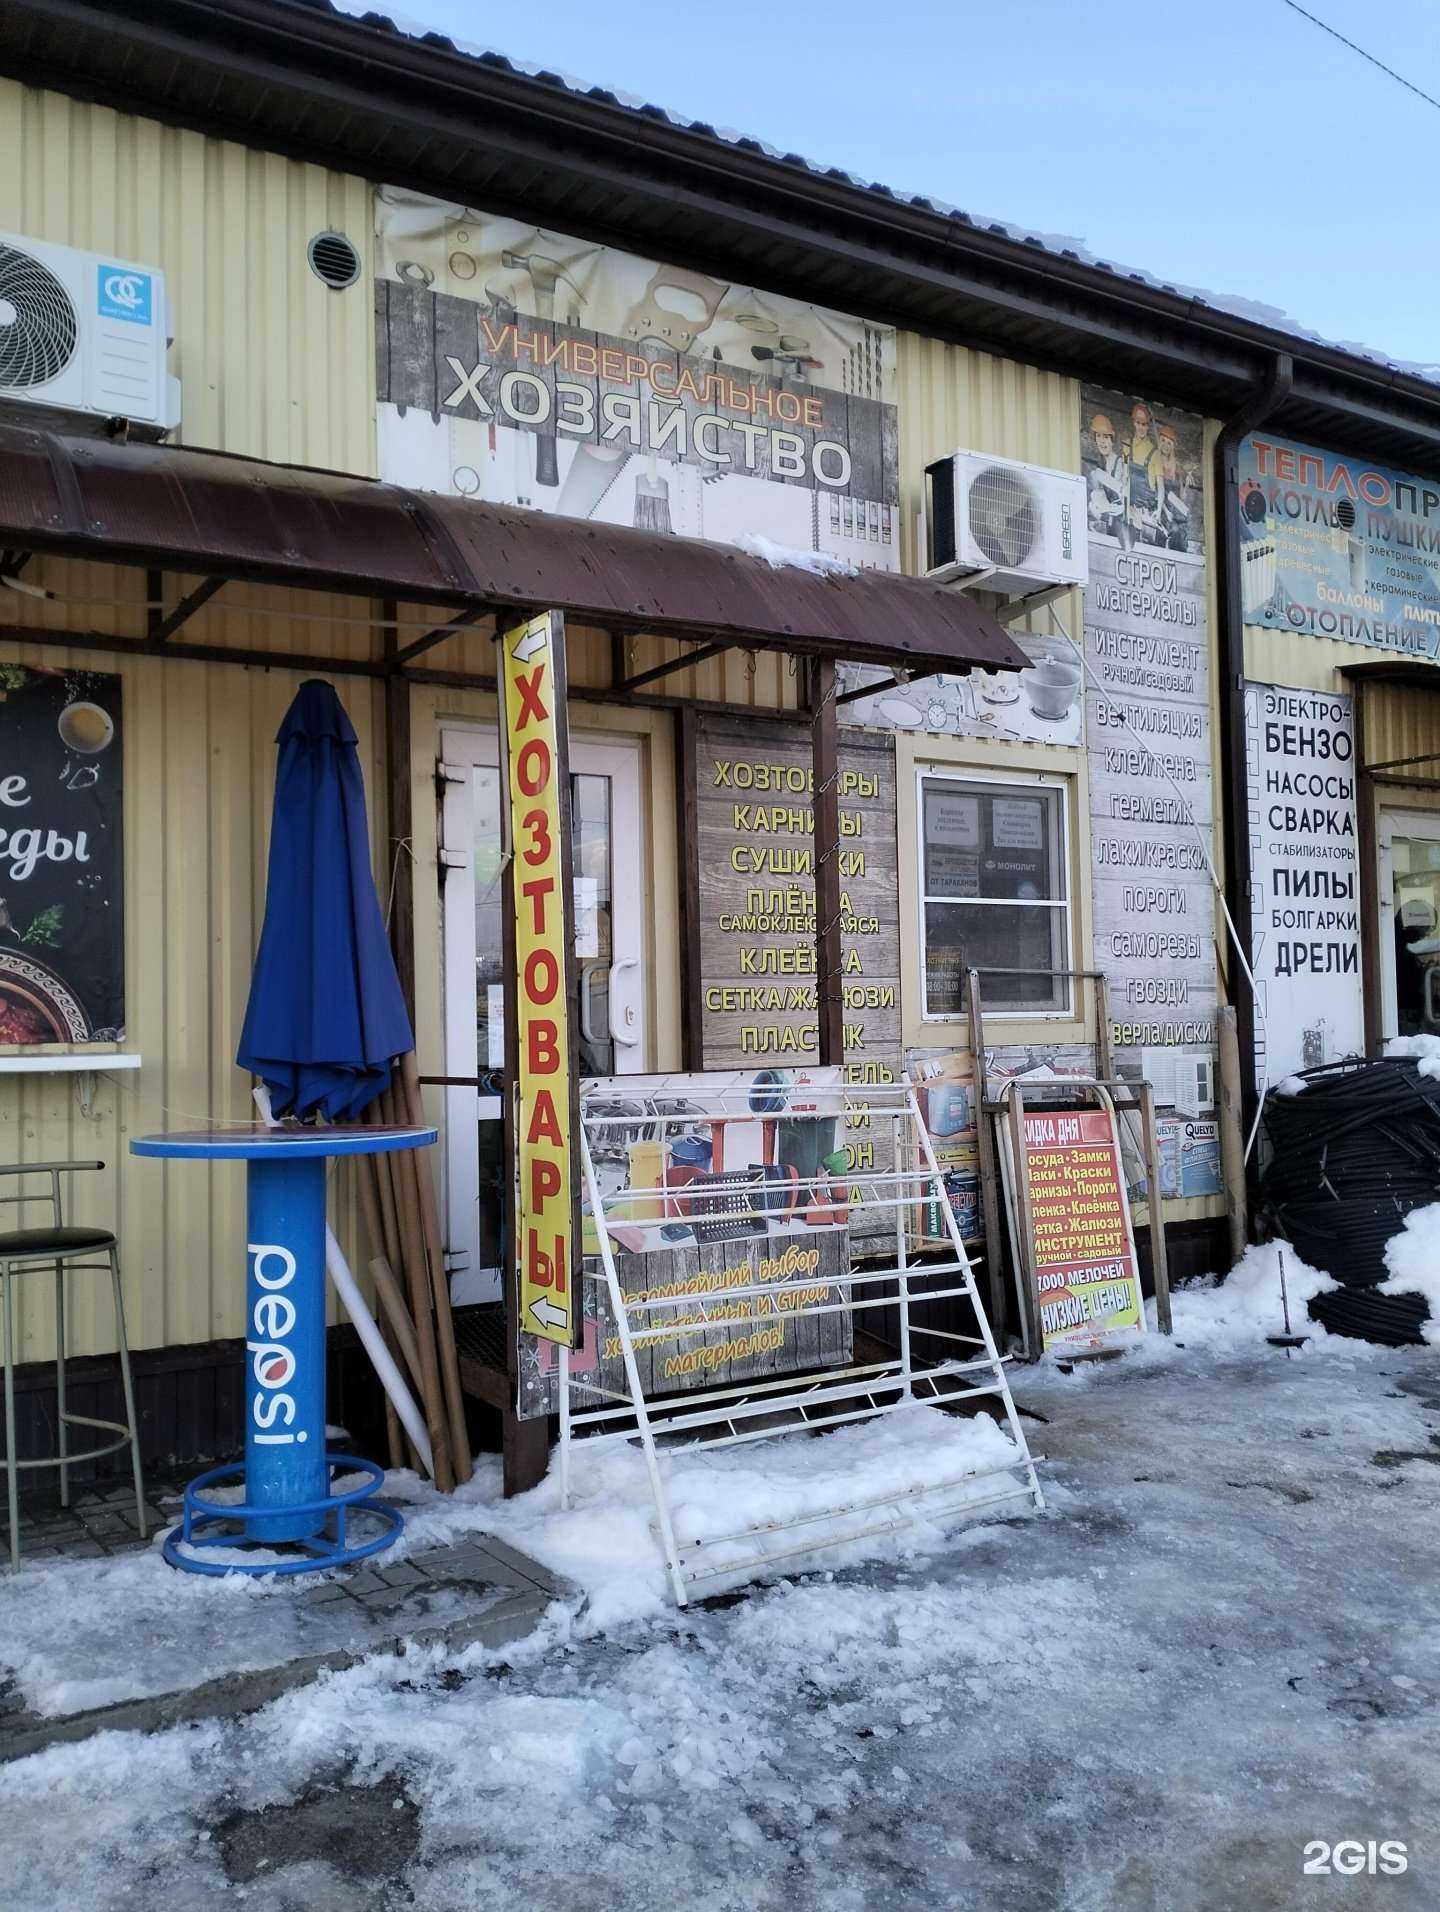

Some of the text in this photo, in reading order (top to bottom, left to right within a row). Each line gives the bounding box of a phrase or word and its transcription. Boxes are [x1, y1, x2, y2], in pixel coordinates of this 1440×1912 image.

[480, 317, 824, 427] УНИВЕРСАЛЬНОЕ
[443, 355, 853, 488] ХОЗЯЙСТВО
[1115, 554, 1178, 595] СТРОЙ
[1286, 603, 1427, 651] ОТОПЛЕНИЕ
[1265, 695, 1351, 723] ЭЛЕКТРО-
[1265, 723, 1352, 762] БЕНЗО
[1266, 770, 1354, 801] НАСОСЫ
[1268, 804, 1355, 837] СВАРКА
[747, 884, 854, 916] ПЛЁНА
[1273, 868, 1354, 900] ПИЛЫ
[1272, 909, 1357, 931] БОЛГАРКИ
[1274, 941, 1359, 977] ДРЕЛИ
[514, 661, 566, 1294] ХОЗТОВАРЫ
[1057, 1118, 1080, 1146] ДНЯ
[1028, 1150, 1111, 1168] осуда Замки
[1063, 1166, 1112, 1182] Краски
[1029, 1181, 1117, 1202] арнизы Пороги
[1071, 1199, 1120, 1215] Клеёнка
[1033, 1218, 1122, 1235] етка Жалюзи
[759, 1245, 820, 1281] выбор
[1036, 1245, 1122, 1265] ручной садовый
[1067, 1260, 1125, 1286] МЕЛОЧЕЙ
[1041, 1295, 1090, 1333] НИЗКИЕ
[247, 1243, 308, 1444] pepsi
